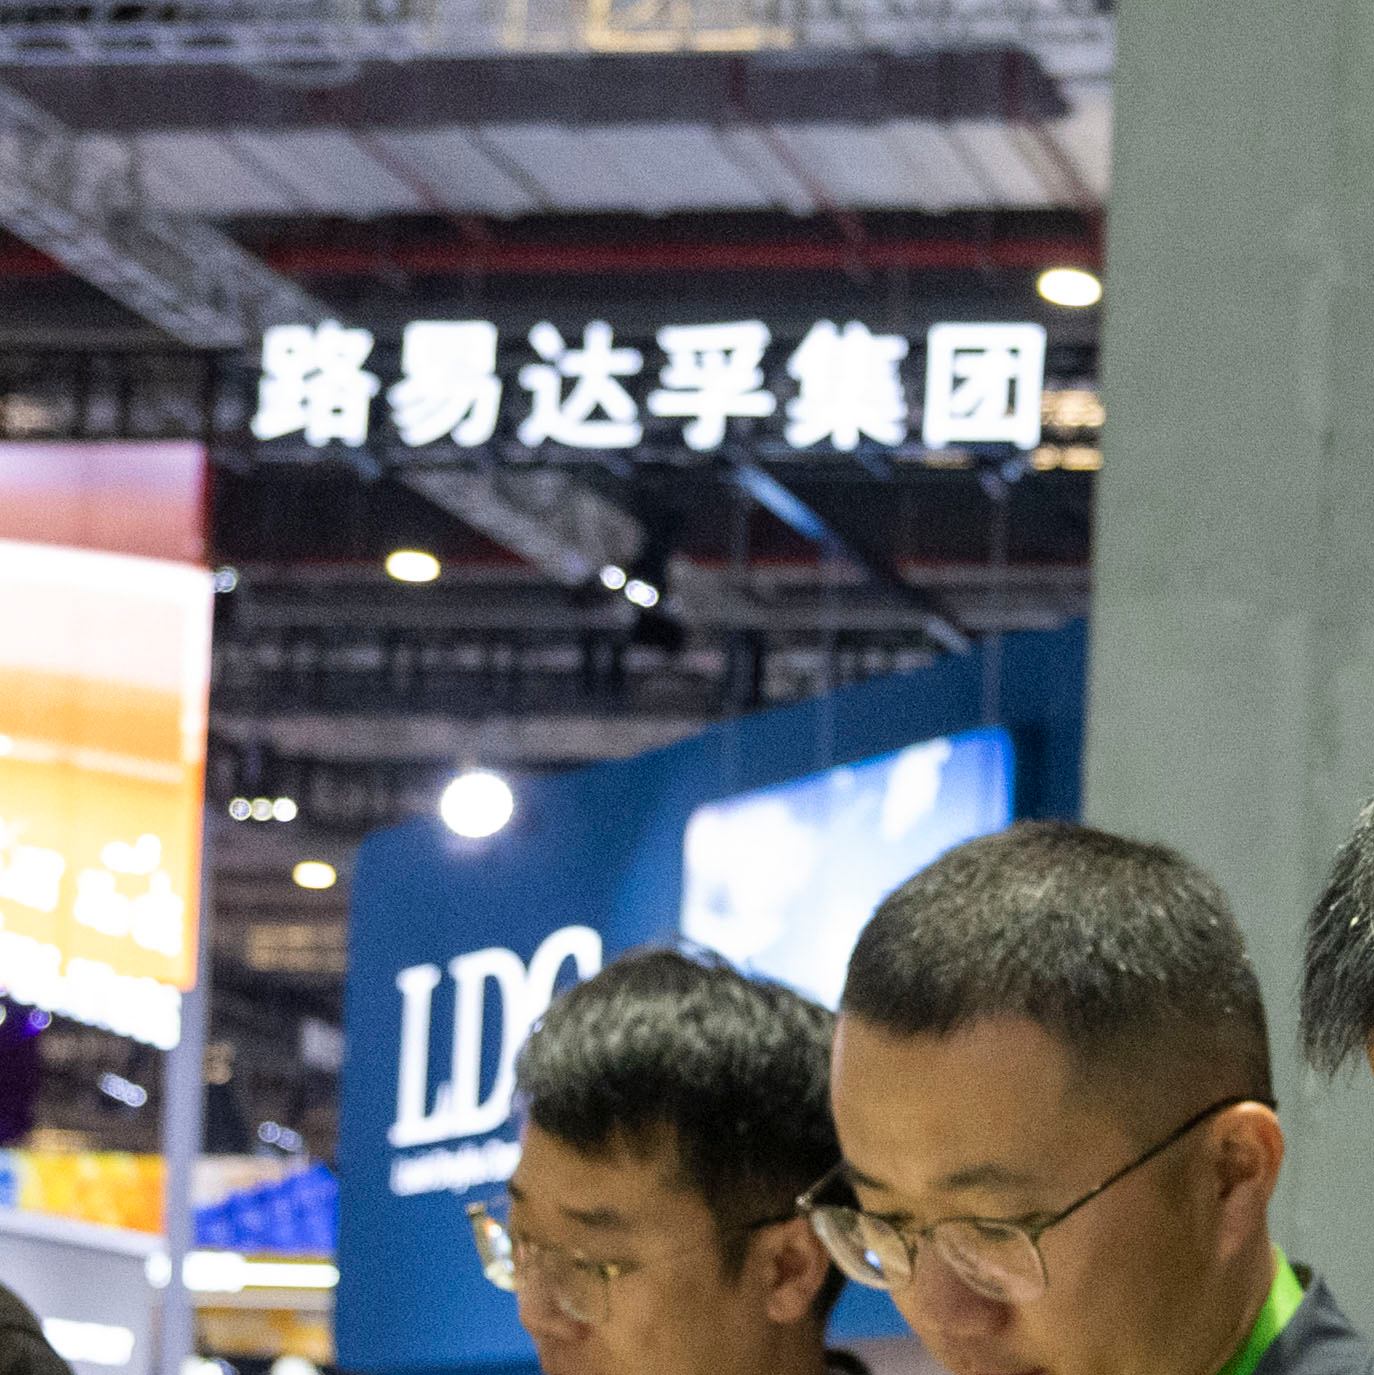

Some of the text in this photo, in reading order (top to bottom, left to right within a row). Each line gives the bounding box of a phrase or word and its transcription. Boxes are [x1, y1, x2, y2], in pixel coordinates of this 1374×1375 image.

[250, 317, 1047, 453] 路易达孚集团
